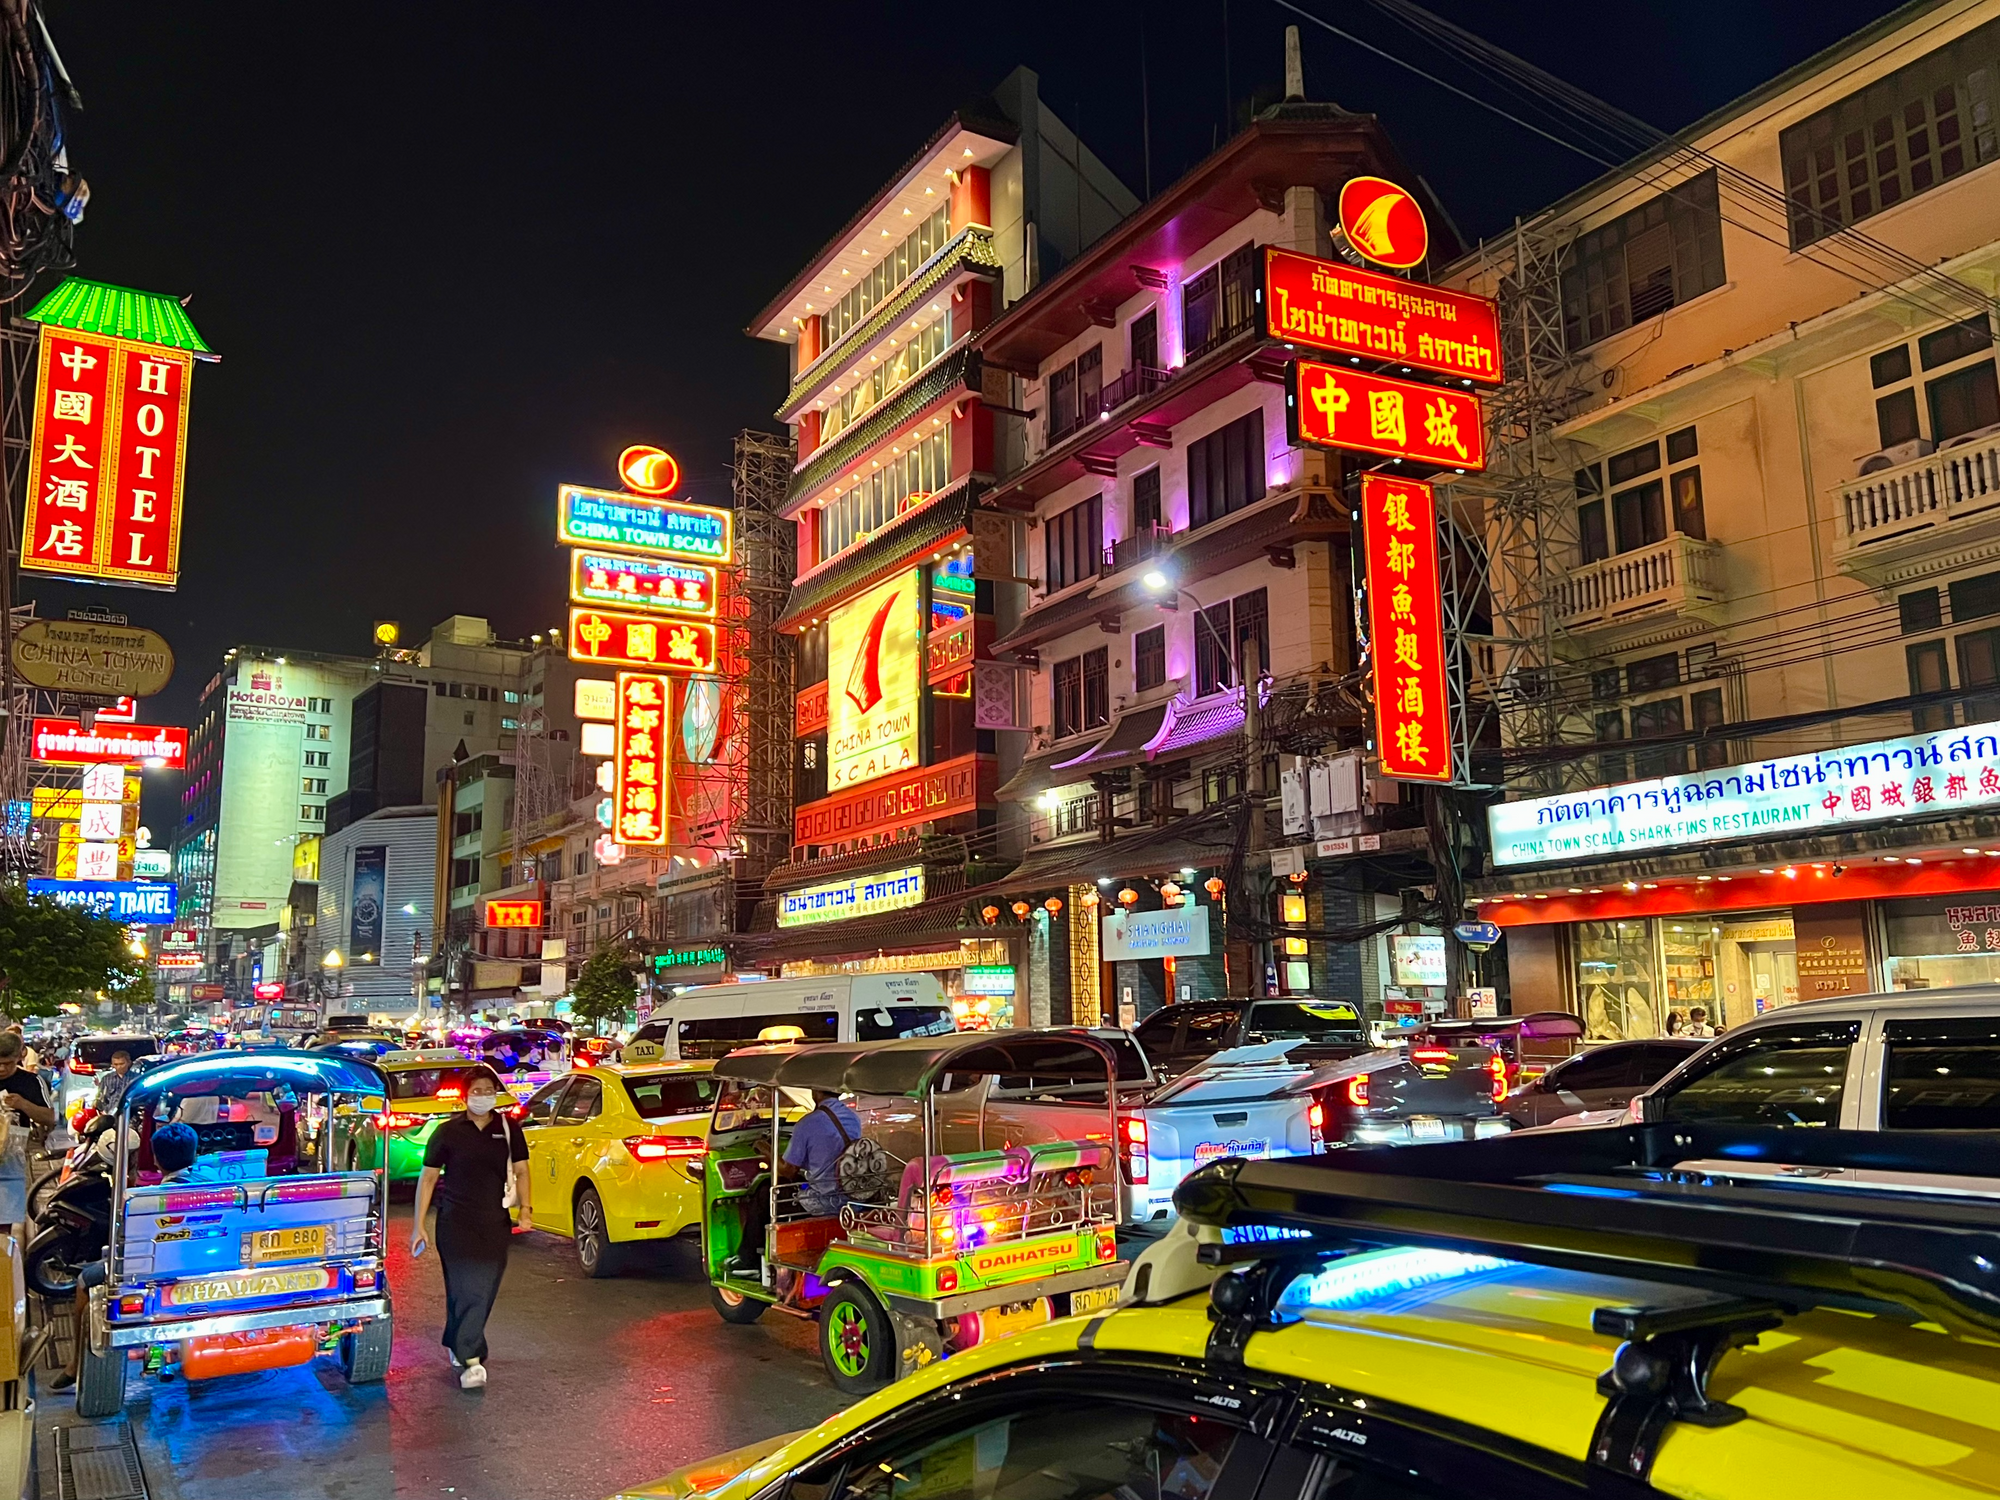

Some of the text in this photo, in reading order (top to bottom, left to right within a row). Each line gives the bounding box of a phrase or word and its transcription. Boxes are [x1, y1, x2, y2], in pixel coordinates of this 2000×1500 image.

[1310, 372, 1468, 459] 中國城
[39, 345, 98, 556] 中國大酒店
[127, 360, 170, 566] HOTEL
[569, 521, 723, 554] CHINA TOWN SCALA
[579, 615, 704, 668] 中國城
[1382, 492, 1430, 767] 銀都魚翅酒樓
[19, 642, 166, 674] CHINA TOWN
[56, 667, 127, 689] HOTEL
[834, 712, 910, 755] CHINA TOWN
[834, 747, 910, 787] SCALA
[1512, 803, 1811, 858] CHINA TOWN SCALA SHARK-FINS RESTAURANT
[119, 892, 171, 914] TRAVEL
[802, 912, 822, 922] TOWN
[823, 910, 846, 920] SCALA
[1128, 919, 1191, 938] SHANGHAI
[1945, 905, 2000, 930] หูฉลา
[1487, 926, 1494, 937] 2
[1842, 976, 1850, 990] 1
[1483, 994, 1494, 1005] 32
[635, 1046, 655, 1056] TAXI
[293, 1229, 319, 1244] 880
[979, 1243, 1072, 1270] DAIHATSU
[177, 1272, 320, 1301] THAILAND
[1209, 1395, 1242, 1409] ALTIS
[1330, 1428, 1367, 1445] ALTIS
